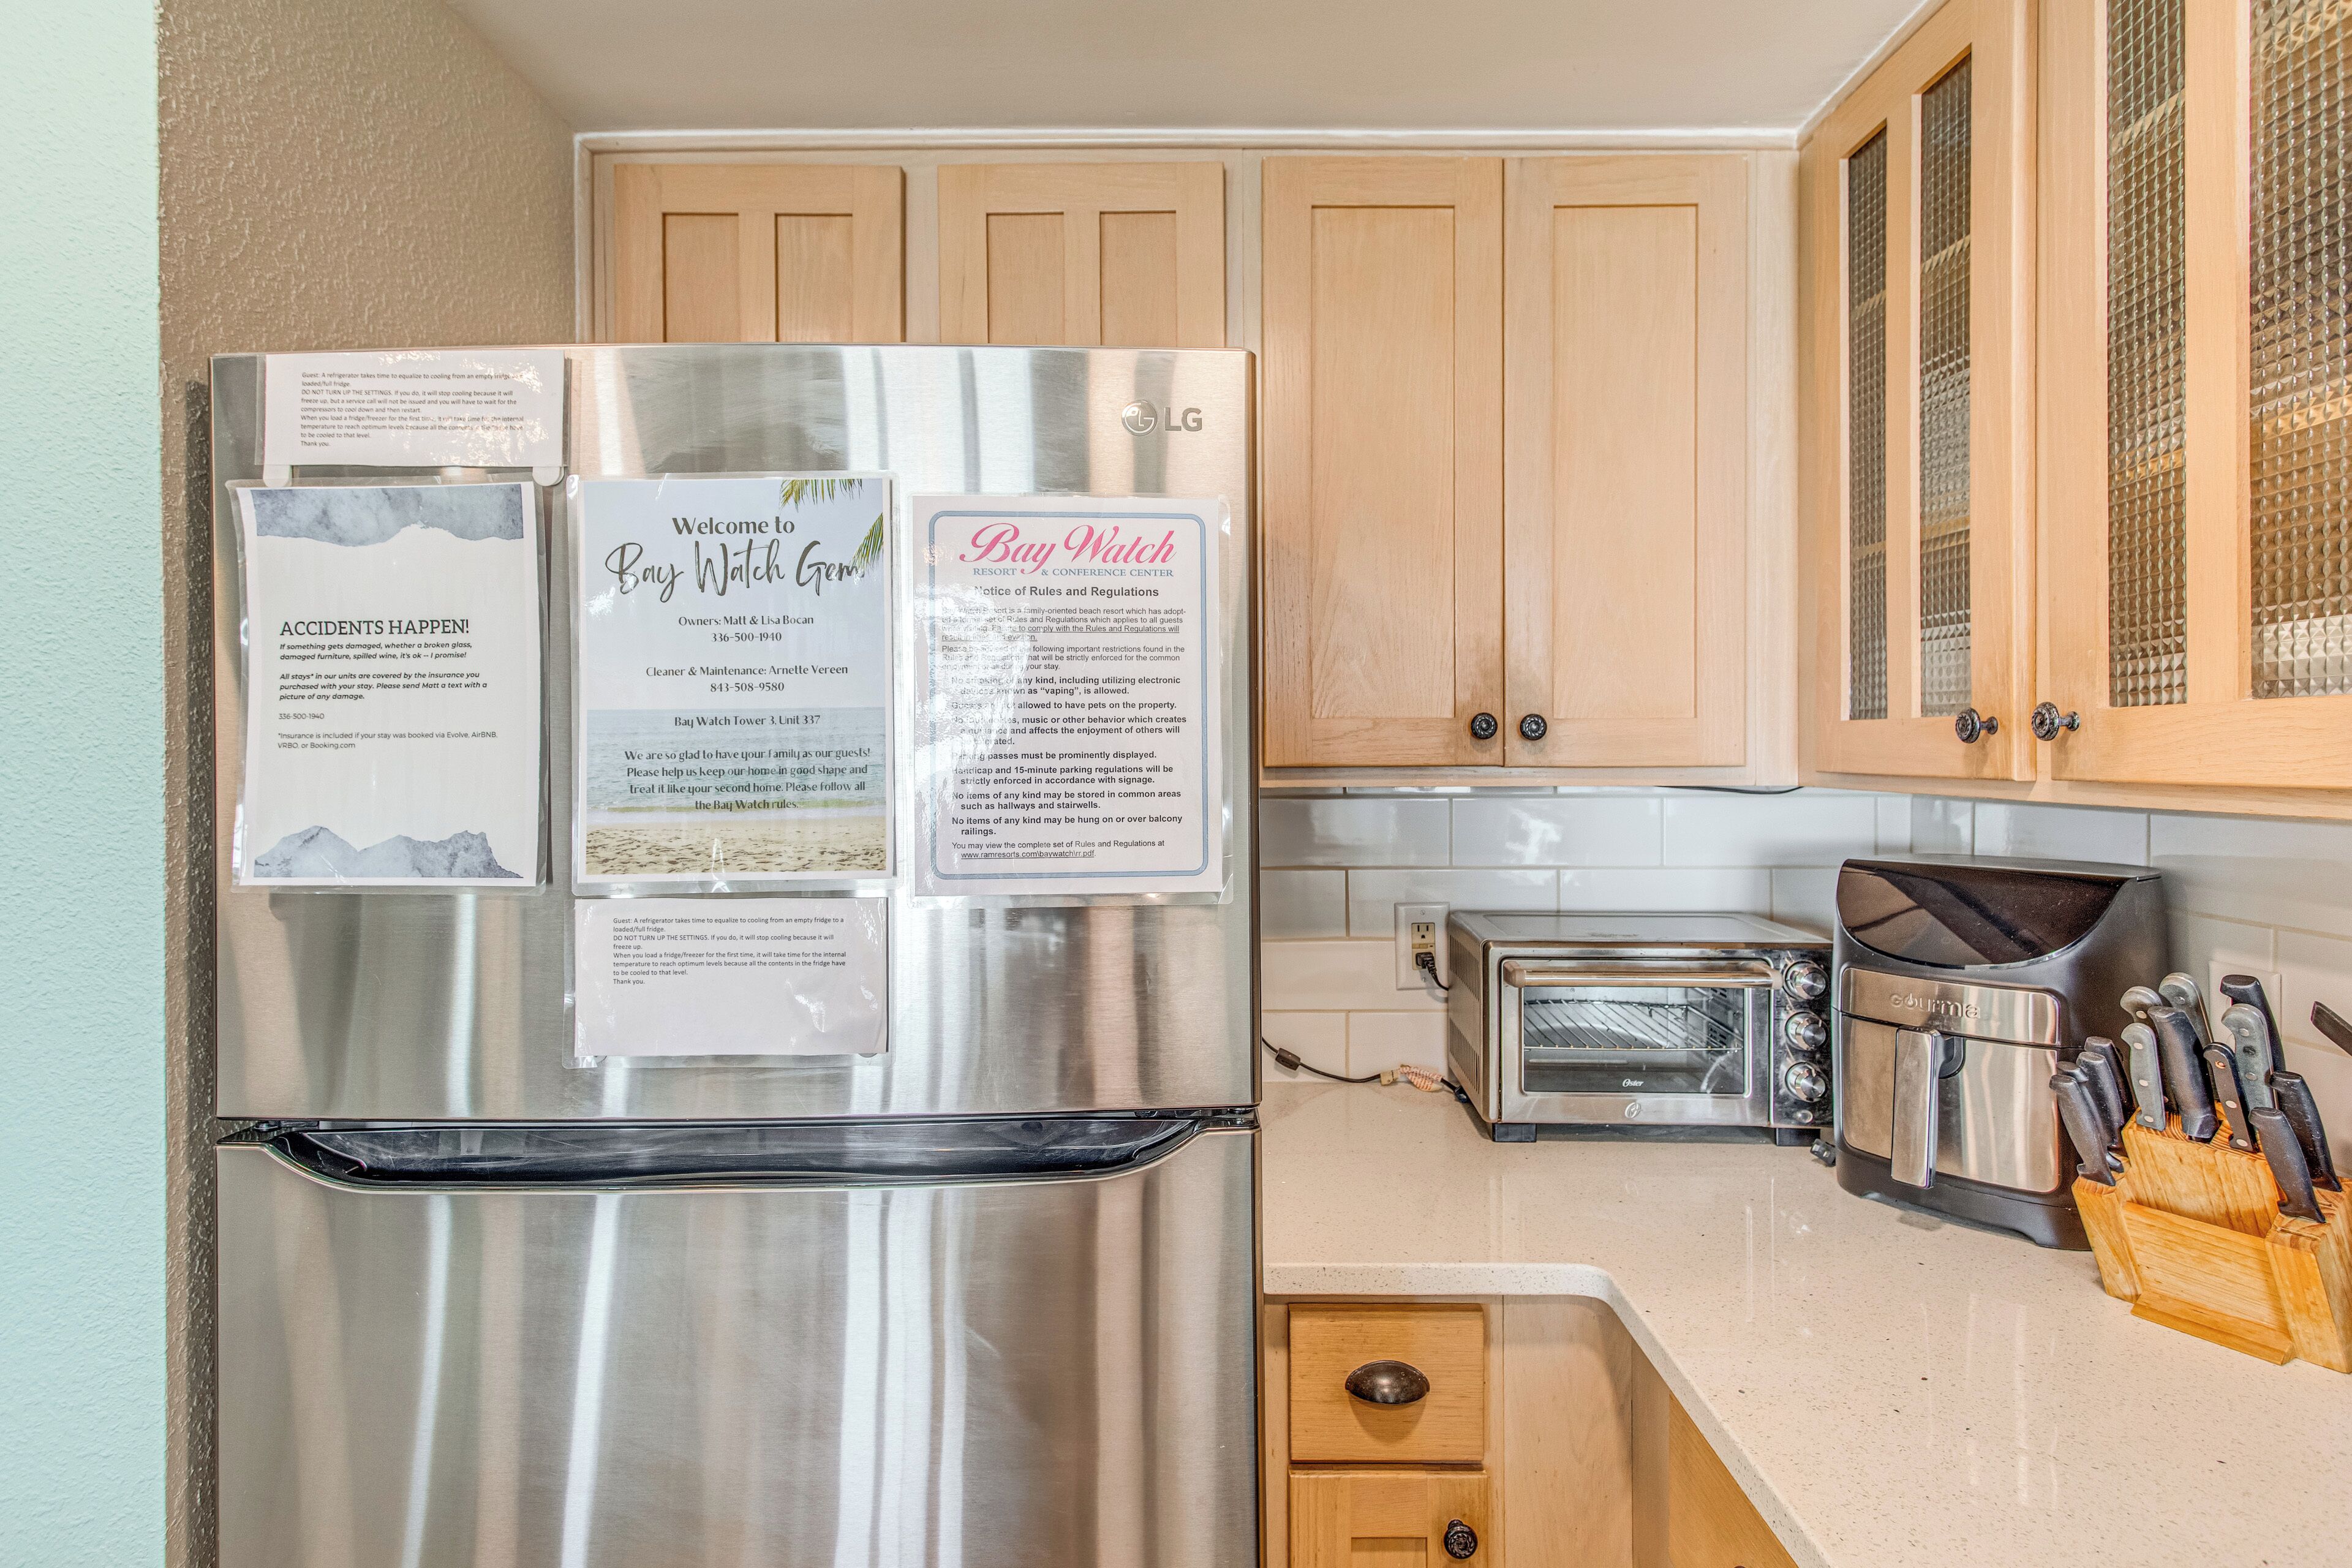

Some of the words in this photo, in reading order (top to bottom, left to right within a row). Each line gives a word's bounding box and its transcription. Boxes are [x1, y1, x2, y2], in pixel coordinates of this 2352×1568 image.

[1164, 407, 1202, 432] LG
[672, 517, 769, 535] Welcome
[774, 516, 795, 533] to
[959, 522, 1056, 575] Bay
[1064, 524, 1177, 564] Watch
[605, 542, 684, 603] Bay
[695, 538, 786, 596] Watch
[1014, 586, 1027, 595] of
[1030, 586, 1062, 596] Rules
[1066, 586, 1087, 596] and
[1091, 586, 1159, 598] Regulations
[678, 616, 721, 625] Owners:
[723, 616, 747, 625] Matt
[749, 616, 758, 625] &
[761, 615, 780, 625] Lisa
[783, 615, 813, 624] Bocan
[279, 620, 383, 636] ACCIDENTS
[388, 619, 469, 635] HAPPEN!
[711, 632, 782, 642] 336-500-1940
[434, 651, 467, 660] promise!
[646, 666, 685, 676] Cleaner
[688, 666, 697, 676] &
[700, 666, 766, 676] Maintenance:
[769, 665, 809, 674] Arnette
[811, 665, 848, 674] Vereen
[710, 682, 784, 692] 843-508-9580
[674, 717, 693, 728] Bay
[696, 716, 730, 726] Watch
[733, 715, 766, 725] Tower
[779, 715, 799, 725] Unit
[802, 715, 820, 725] 337
[960, 777, 990, 786] strictly
[993, 776, 1031, 785] enforced
[1118, 775, 1155, 785] signage.
[628, 783, 655, 794] treat
[658, 784, 665, 793] it
[667, 783, 685, 793] like
[687, 785, 712, 796] your
[714, 783, 750, 795] second
[753, 782, 783, 792] home.
[785, 781, 817, 793] Please
[820, 782, 851, 791] follow
[854, 781, 865, 791] all
[695, 800, 711, 810] the
[712, 800, 733, 812] Bay
[734, 799, 769, 809] Watch
[772, 799, 798, 809] rules.
[998, 802, 1036, 811] hallways
[1077, 815, 1099, 825] hung
[1148, 815, 1182, 824] balcony
[961, 827, 996, 837] railings.
[1622, 1078, 1644, 1087] Oster
